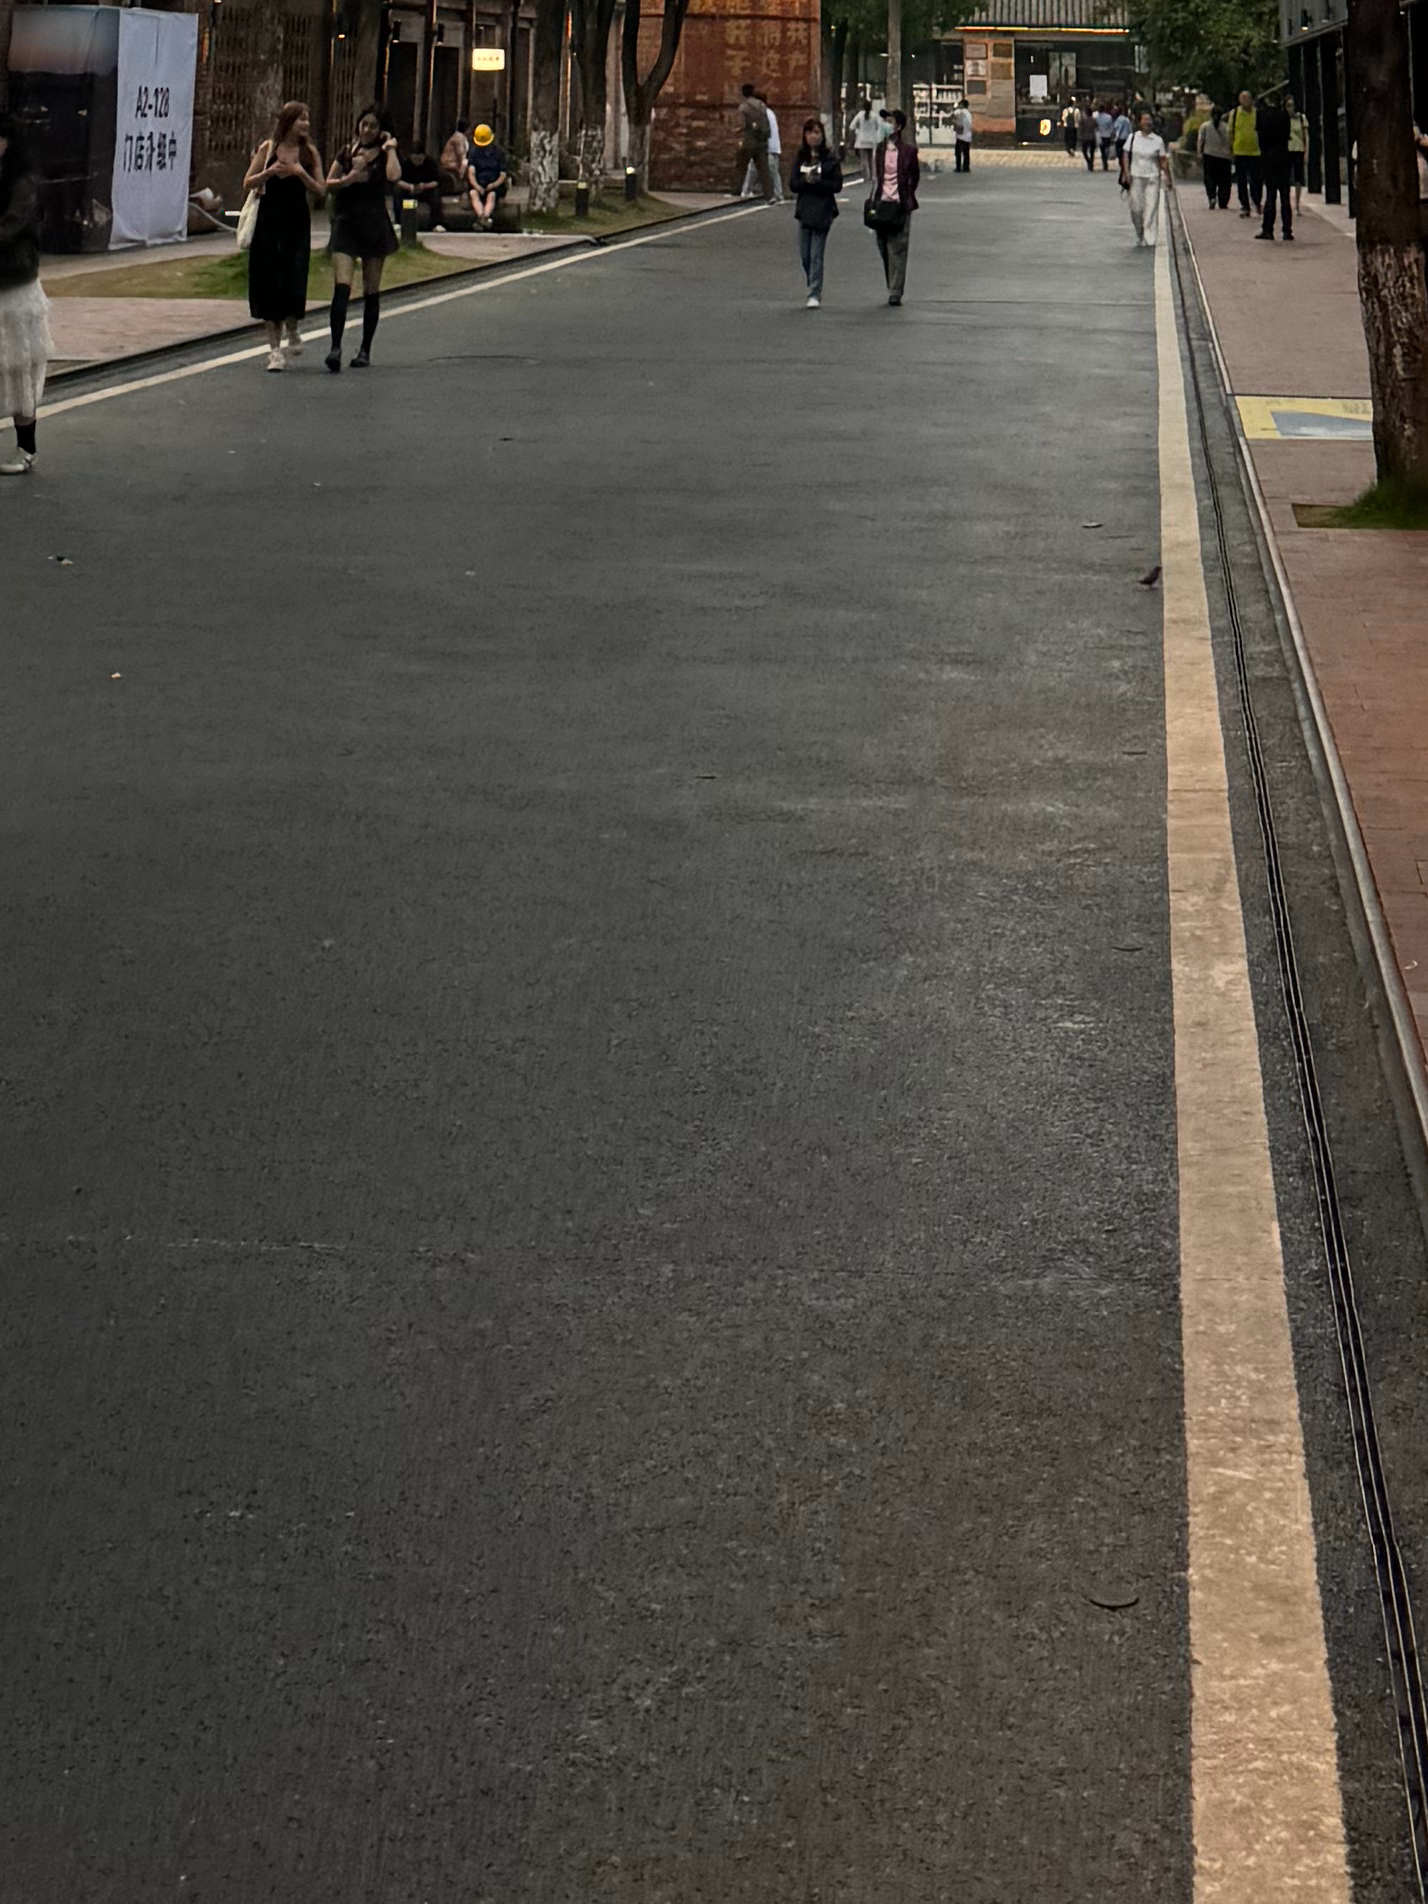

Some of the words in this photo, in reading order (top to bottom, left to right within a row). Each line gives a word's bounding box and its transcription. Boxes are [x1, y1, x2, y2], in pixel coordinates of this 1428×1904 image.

[123, 131, 177, 173] 门店升级中
